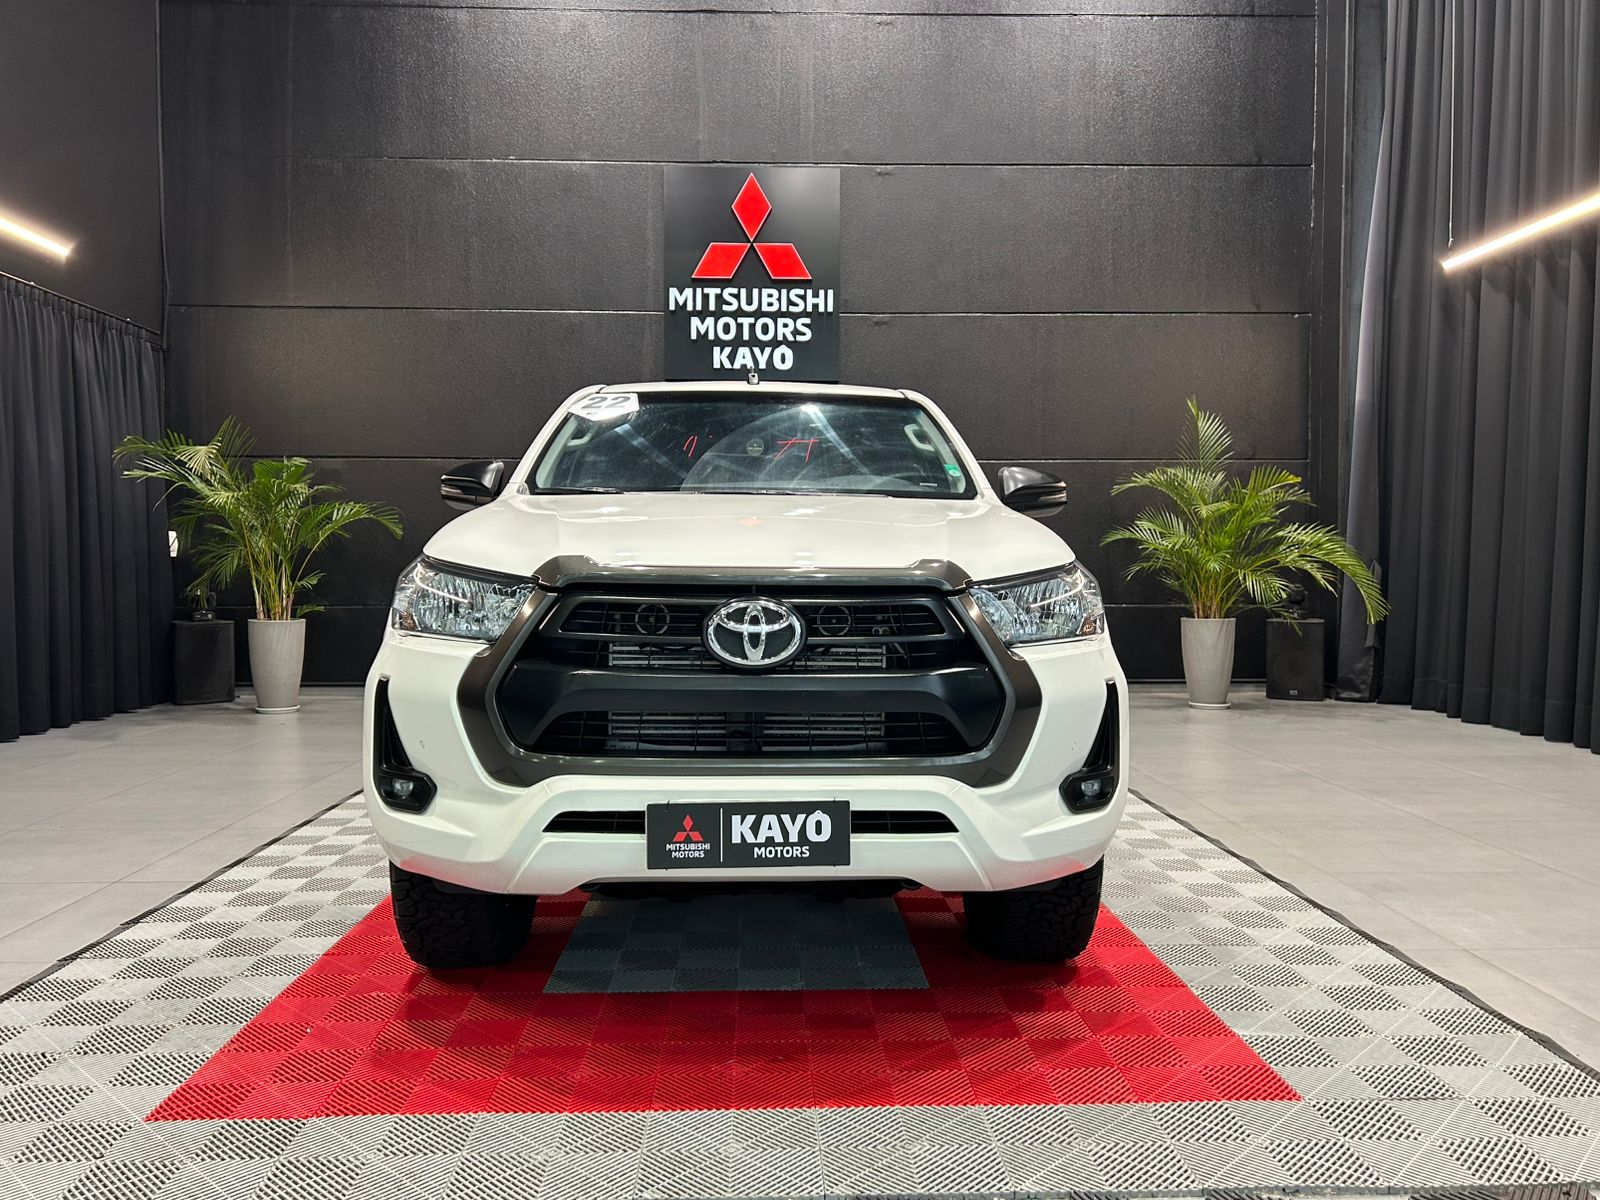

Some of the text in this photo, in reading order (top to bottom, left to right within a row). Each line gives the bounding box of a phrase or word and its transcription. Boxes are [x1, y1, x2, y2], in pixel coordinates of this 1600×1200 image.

[668, 287, 834, 313] MITSUBISHI
[690, 316, 812, 342] MOTORS
[712, 344, 794, 371] KAYÔ
[581, 395, 631, 409] 22
[731, 809, 832, 844] KAYÔ
[666, 842, 711, 851] MITSUBISHI
[671, 850, 705, 858] MOTORS
[754, 846, 810, 858] MOTORS
